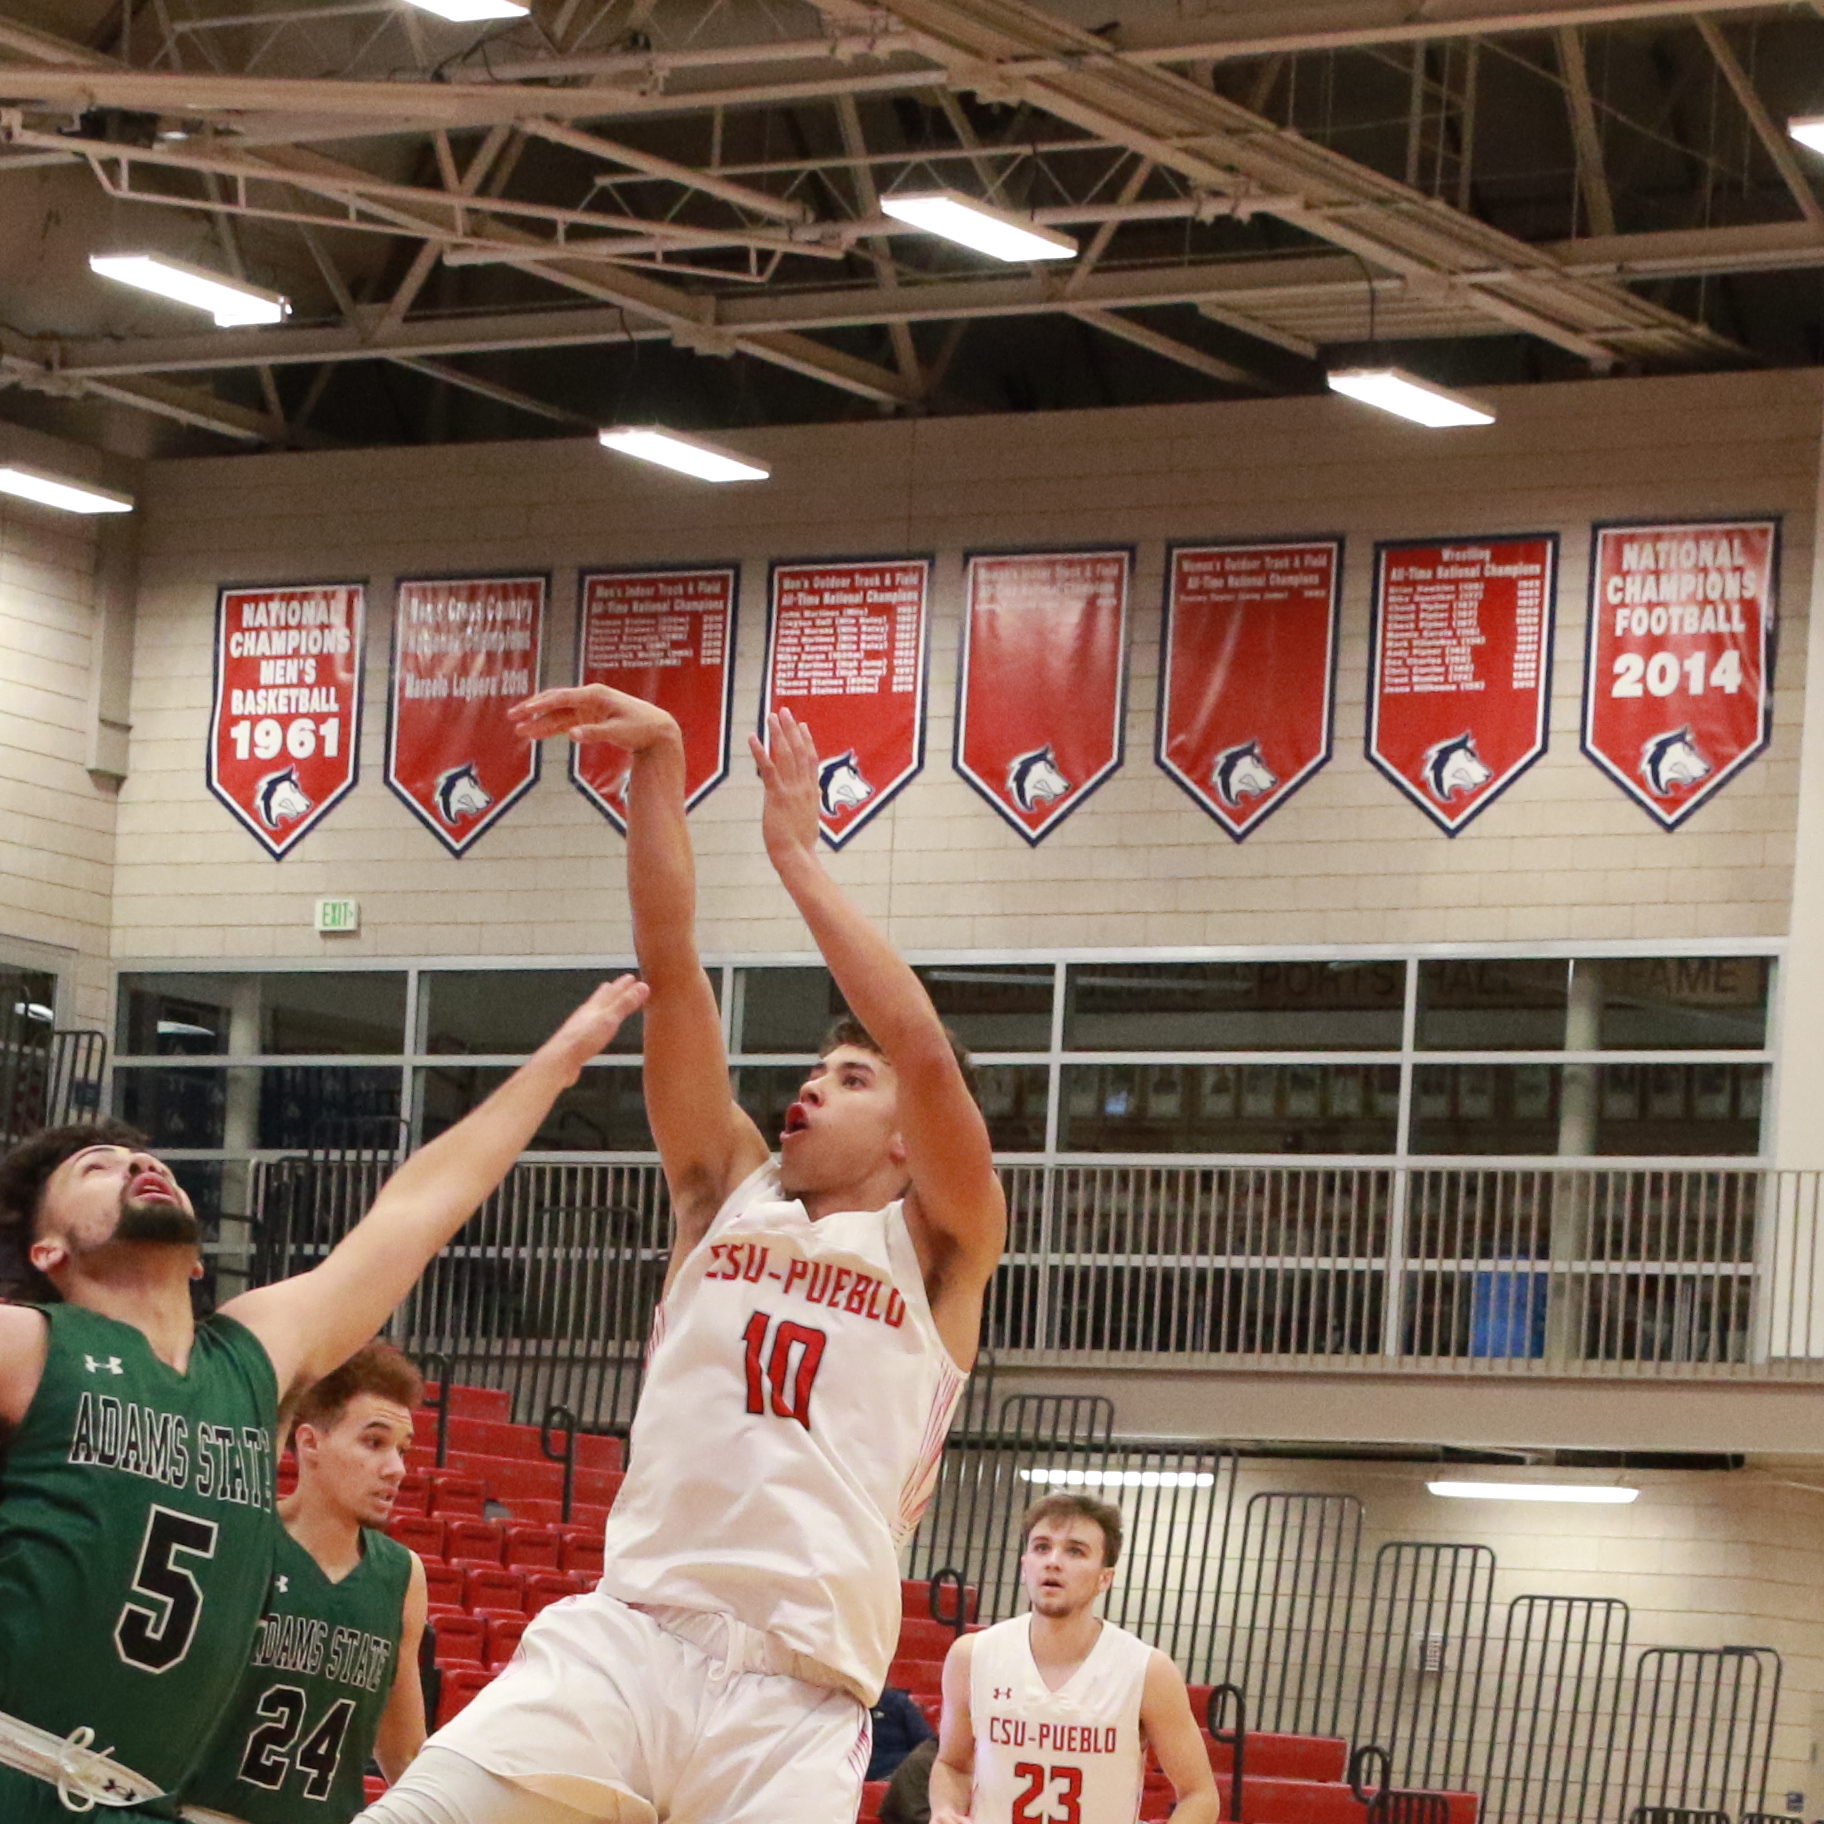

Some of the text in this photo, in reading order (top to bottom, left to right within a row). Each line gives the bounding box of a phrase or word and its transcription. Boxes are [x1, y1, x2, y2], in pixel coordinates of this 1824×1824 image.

[1390, 561, 1542, 582] All-Time National Champions
[1621, 538, 1745, 573] NATIONAL
[781, 588, 919, 607] All-Time National Champions
[782, 572, 920, 590] Men's Outdoor Track & Field
[1606, 570, 1758, 605] CHAMPIONS
[241, 599, 347, 629] NATIONAL
[1614, 604, 1746, 638] FOOTBALL
[229, 627, 352, 660] CHAMPIONS
[259, 657, 318, 687] MEN'S
[1611, 649, 1743, 699] 2014
[231, 686, 341, 717] BASKETBALL
[230, 717, 341, 761] 1961
[322, 901, 349, 927] EXIT
[741, 1310, 827, 1431] 10
[68, 1392, 189, 1488] ADAMS
[113, 1502, 219, 1676] 5
[325, 1625, 392, 1693] STATE
[238, 1684, 356, 1801] 24
[988, 1716, 1119, 1756] CSU-PUEBLO
